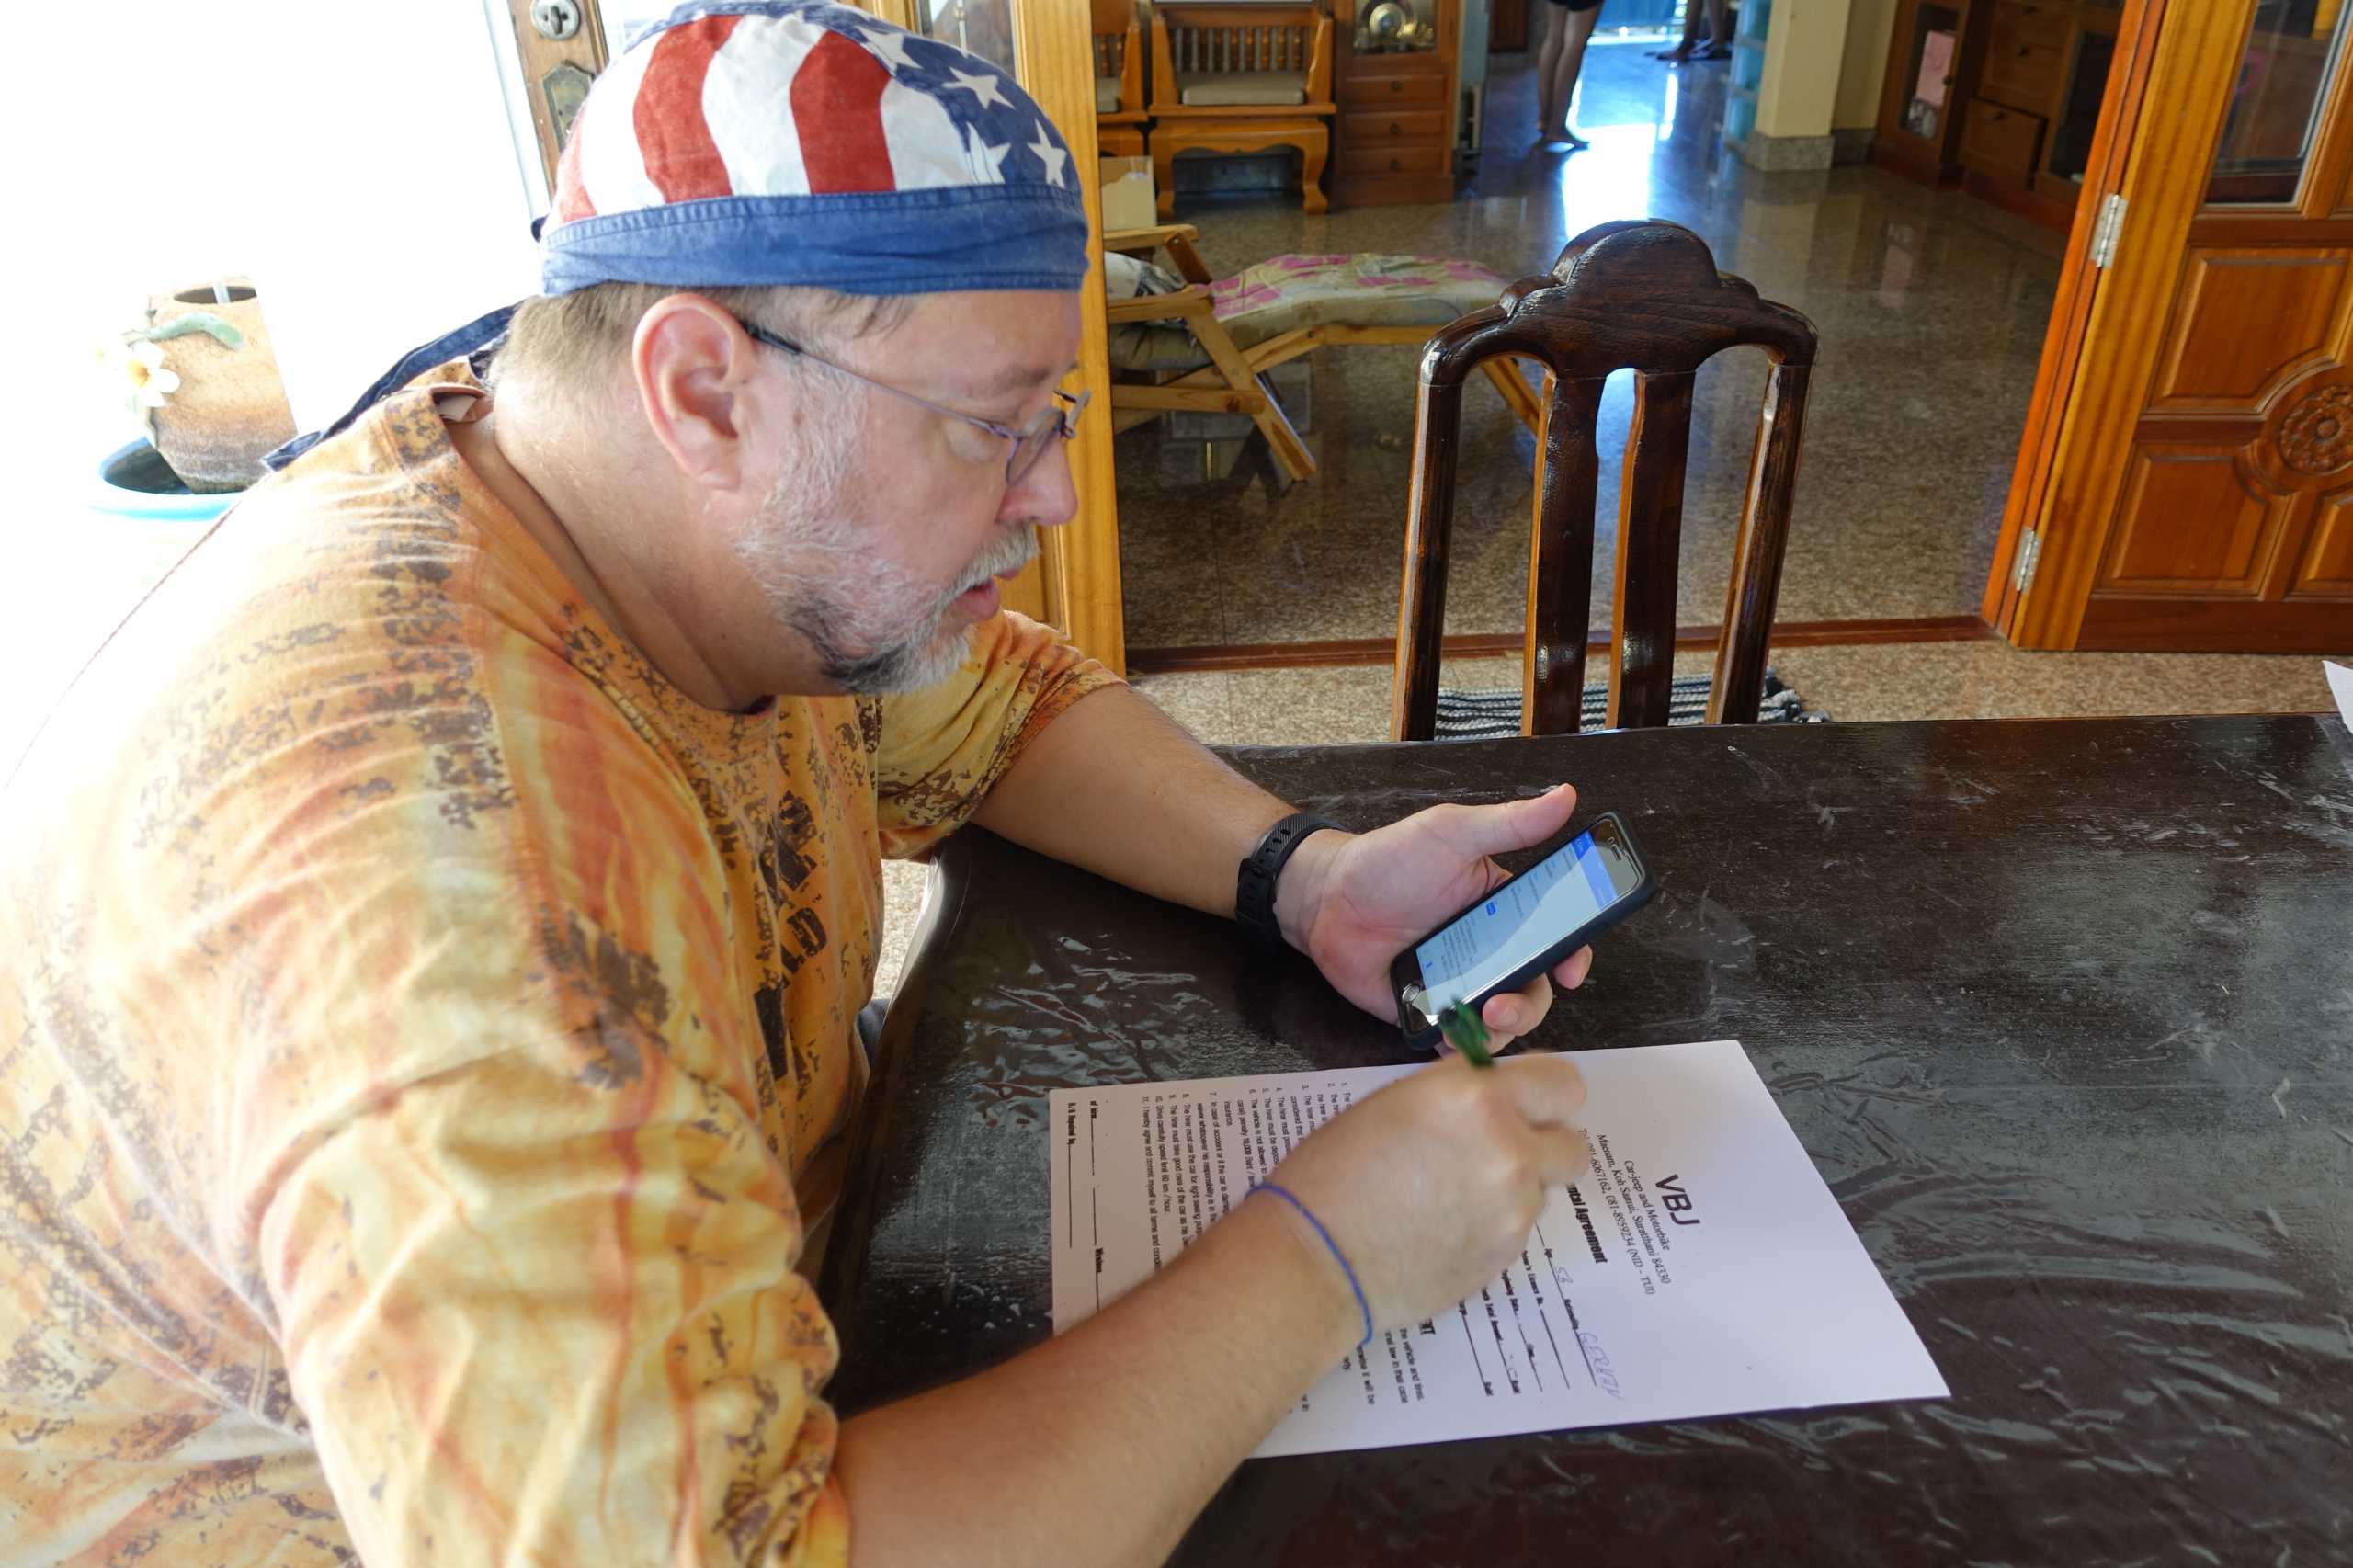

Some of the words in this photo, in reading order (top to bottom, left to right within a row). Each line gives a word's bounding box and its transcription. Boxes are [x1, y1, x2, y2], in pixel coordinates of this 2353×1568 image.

[1594, 1134, 1620, 1167] Maenam,
[1610, 1169, 1628, 1185] Koh
[1620, 1160, 1646, 1191] Car-jeep
[1617, 1187, 1641, 1213] Samui,
[1637, 1193, 1653, 1207] and
[1651, 1173, 1701, 1226] VBJ
[1572, 1207, 1609, 1263] Agreement
[1604, 1195, 1637, 1246] 081-8959234
[1631, 1215, 1660, 1256] Suratthani
[1644, 1209, 1674, 1250] Motorbike
[1650, 1257, 1673, 1283] 84330
